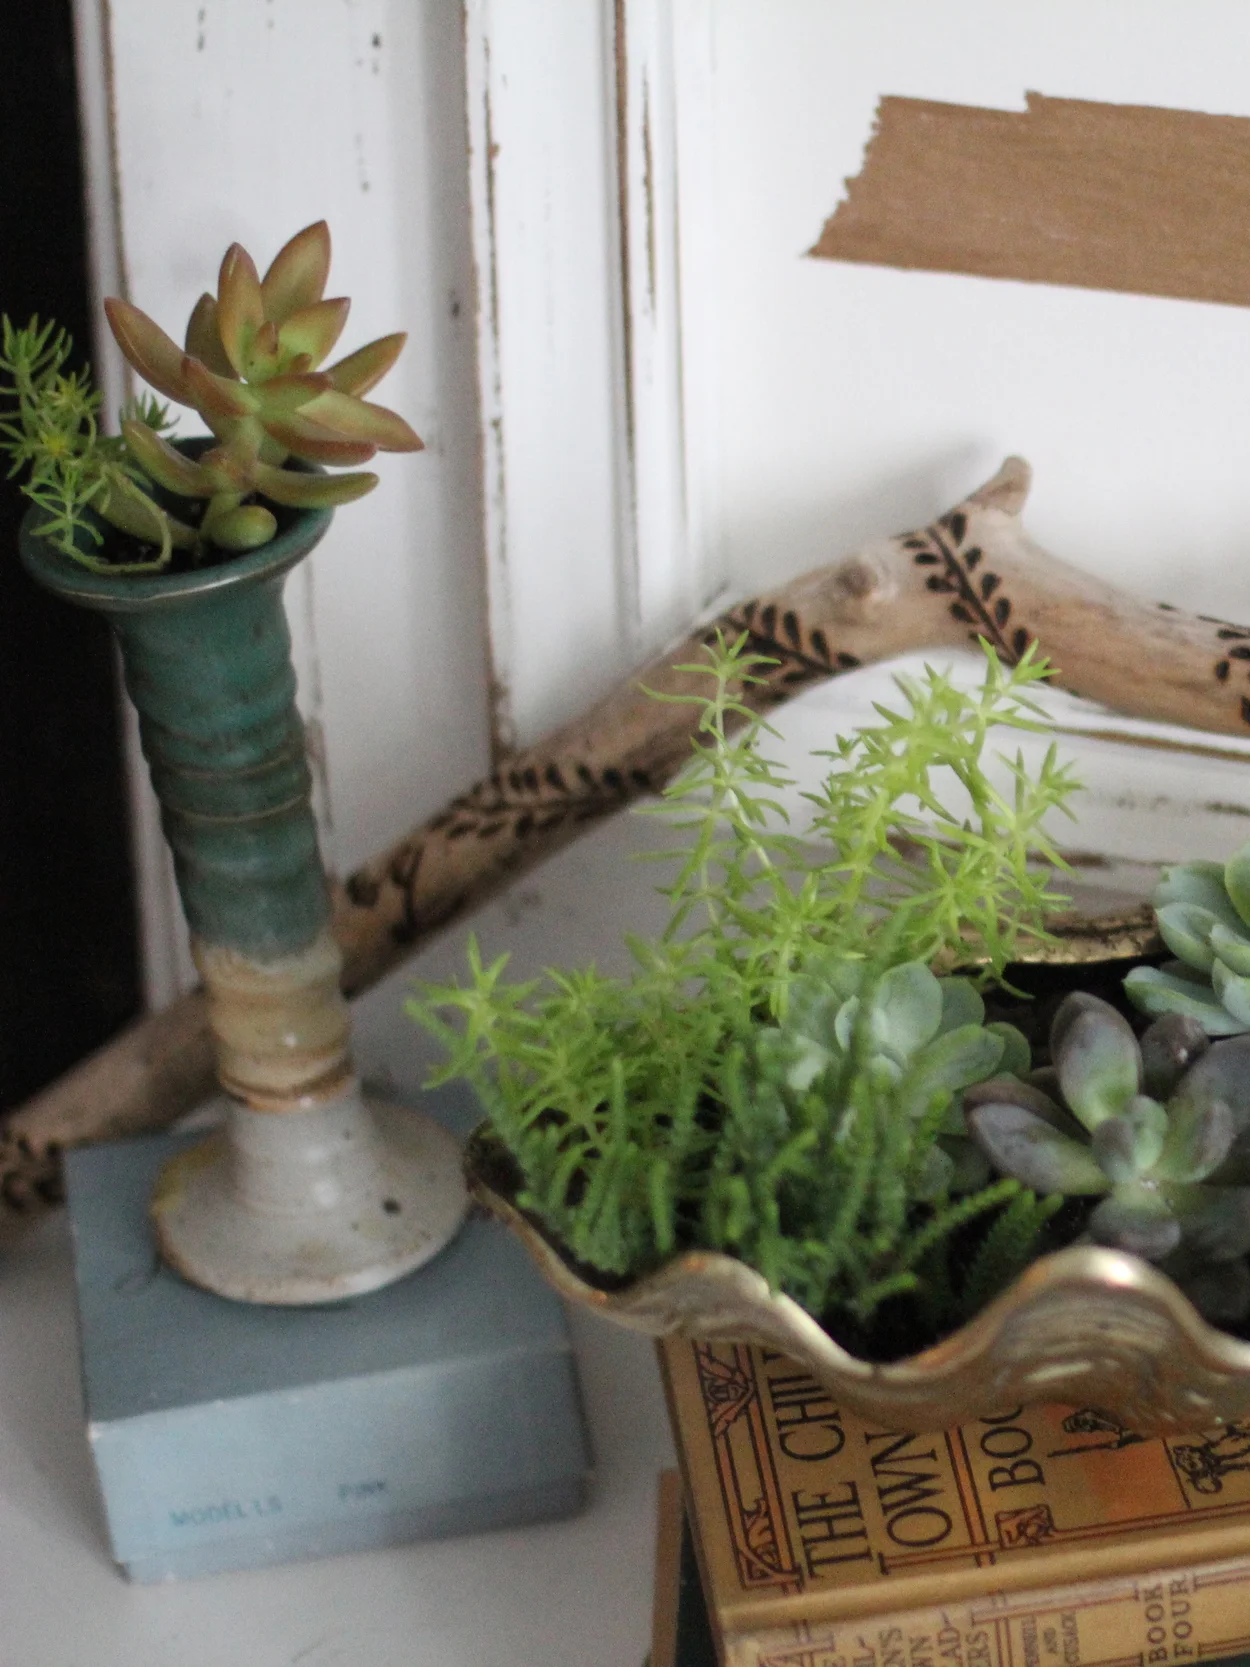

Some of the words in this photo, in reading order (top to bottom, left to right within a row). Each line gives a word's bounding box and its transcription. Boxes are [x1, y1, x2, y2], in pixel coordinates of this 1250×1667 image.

[791, 1480, 874, 1580] THE
[864, 1430, 953, 1548] OWN
[1145, 1583, 1168, 1663] BOOK
[1169, 1576, 1193, 1658] FOUR
